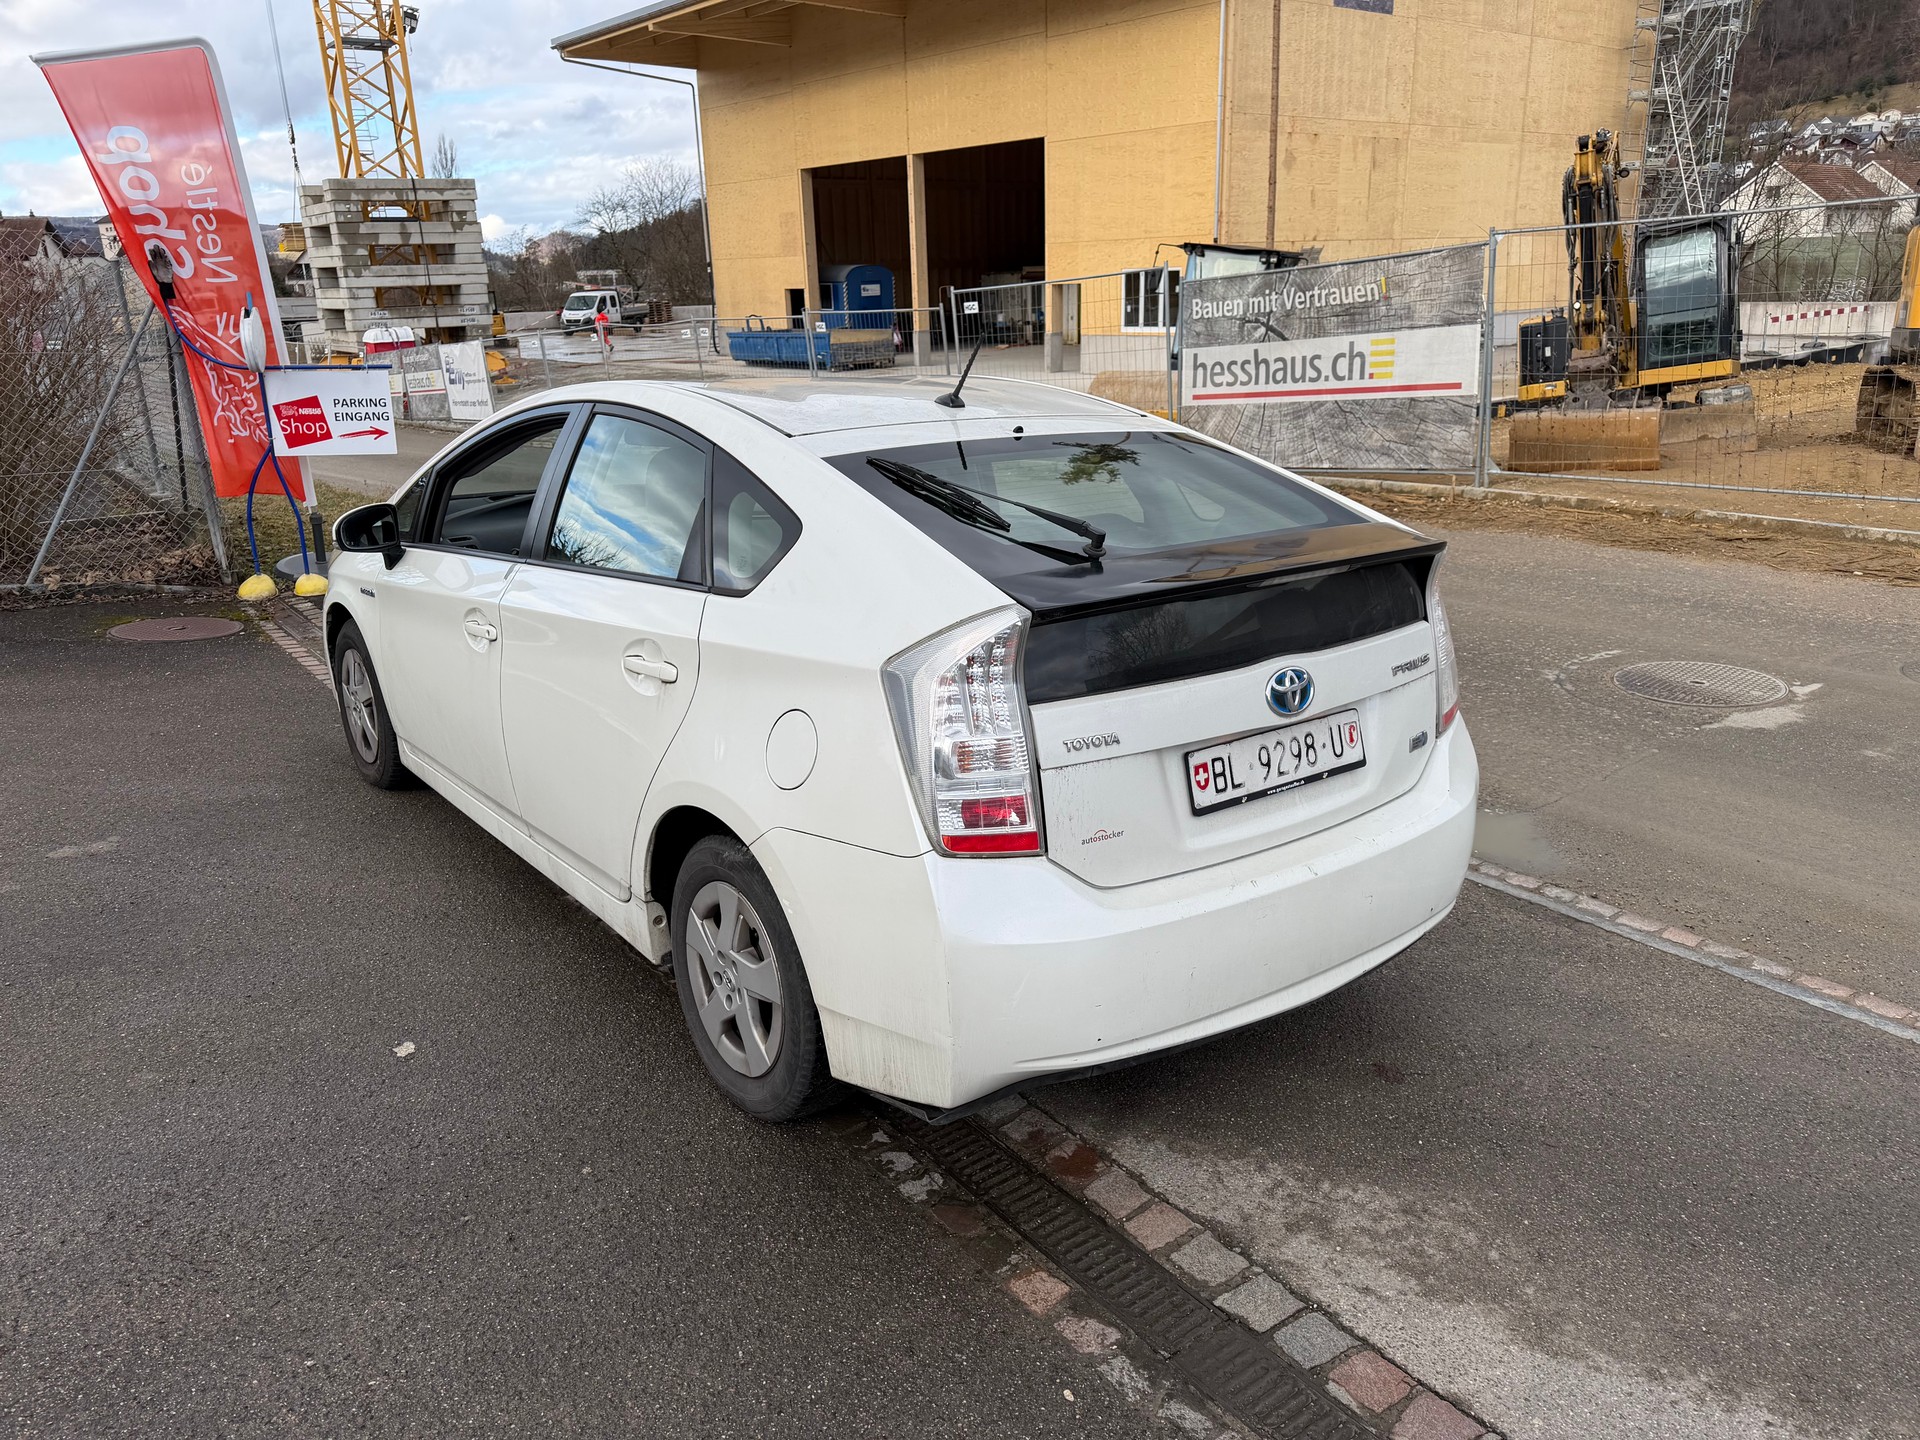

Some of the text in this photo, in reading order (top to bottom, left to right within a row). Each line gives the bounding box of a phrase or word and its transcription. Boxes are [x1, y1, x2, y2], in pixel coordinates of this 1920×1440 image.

[1192, 276, 1389, 319] Bauen mit Vertrauen!
[1191, 340, 1367, 389] hesshaus.ch
[333, 398, 387, 408] PARKING
[334, 411, 390, 422] EINGANG
[279, 418, 328, 438] Shop
[1063, 732, 1120, 753] TOYOTA
[1211, 723, 1344, 794] BL 9298 U
[1081, 829, 1125, 846] autostocker
